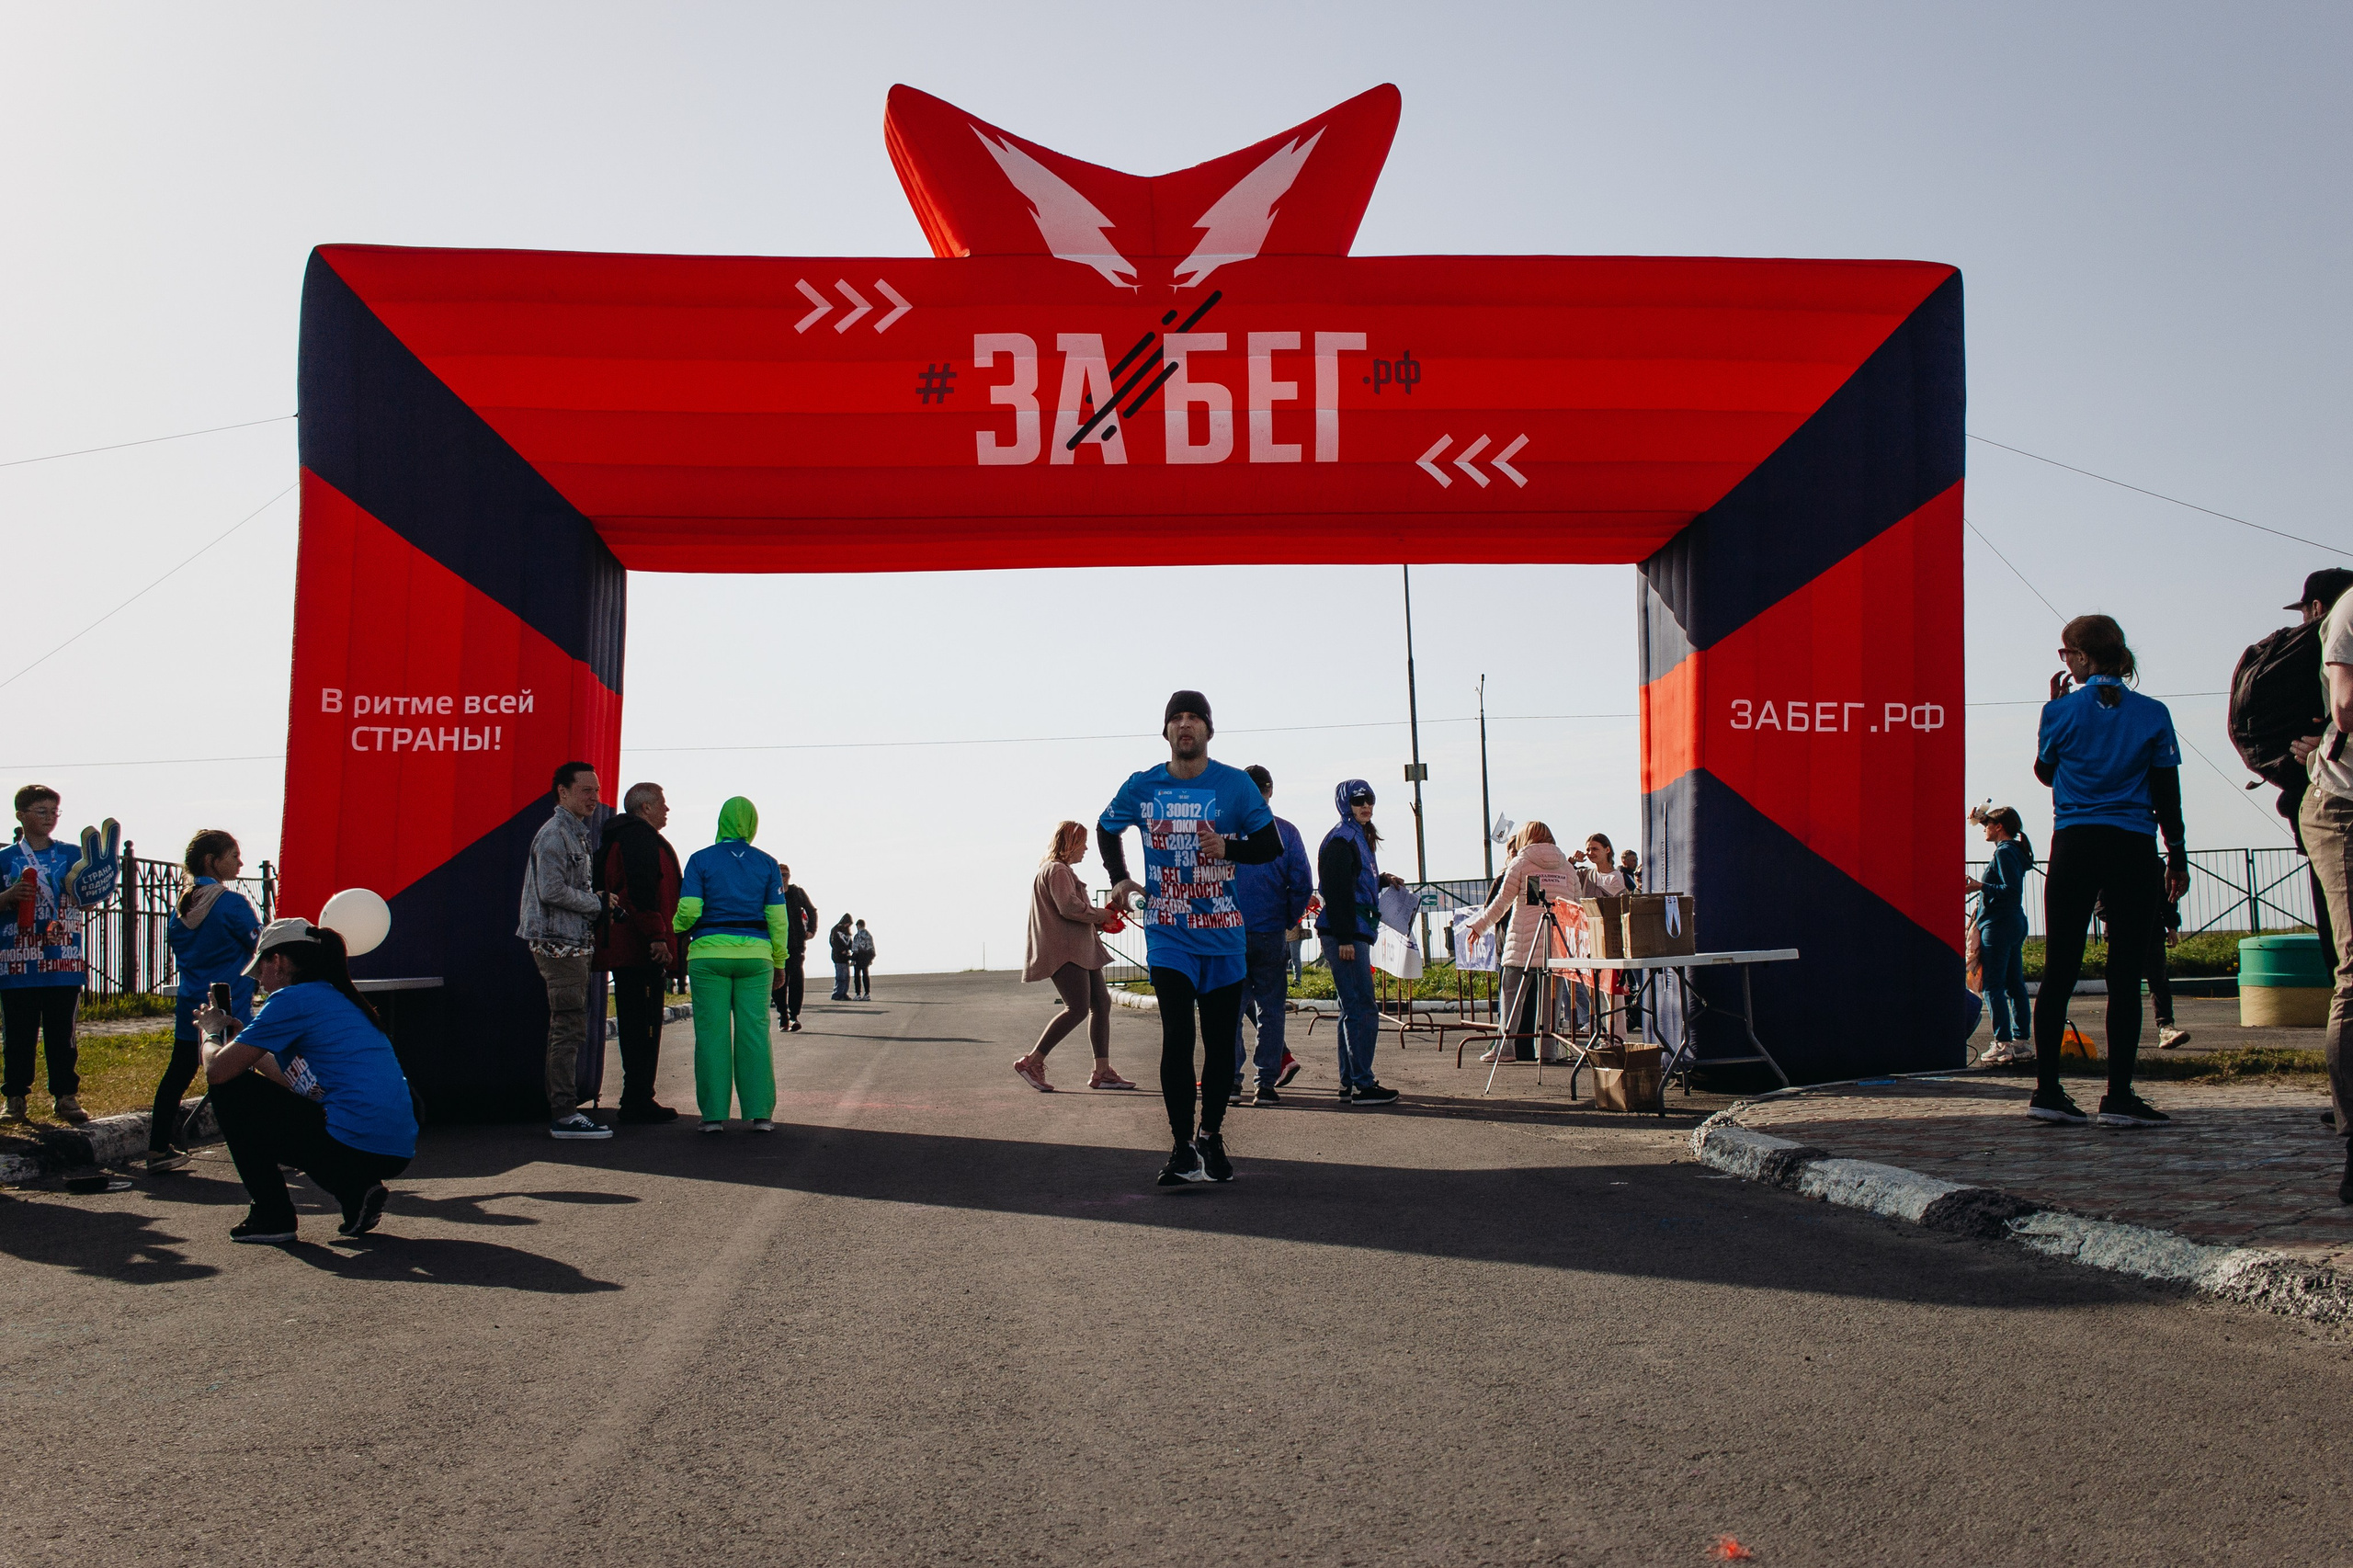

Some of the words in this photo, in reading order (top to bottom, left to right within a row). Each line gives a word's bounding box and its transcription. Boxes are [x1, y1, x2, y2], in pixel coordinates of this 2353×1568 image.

[322, 687, 343, 713] В
[354, 694, 454, 718] ритме
[464, 688, 534, 714] всей
[1730, 699, 1945, 733] ЗАБЕГ.РФ
[351, 725, 502, 752] СТРАНЫ!
[1165, 802, 1202, 818] 30012
[83, 864, 113, 884] СТРАНА
